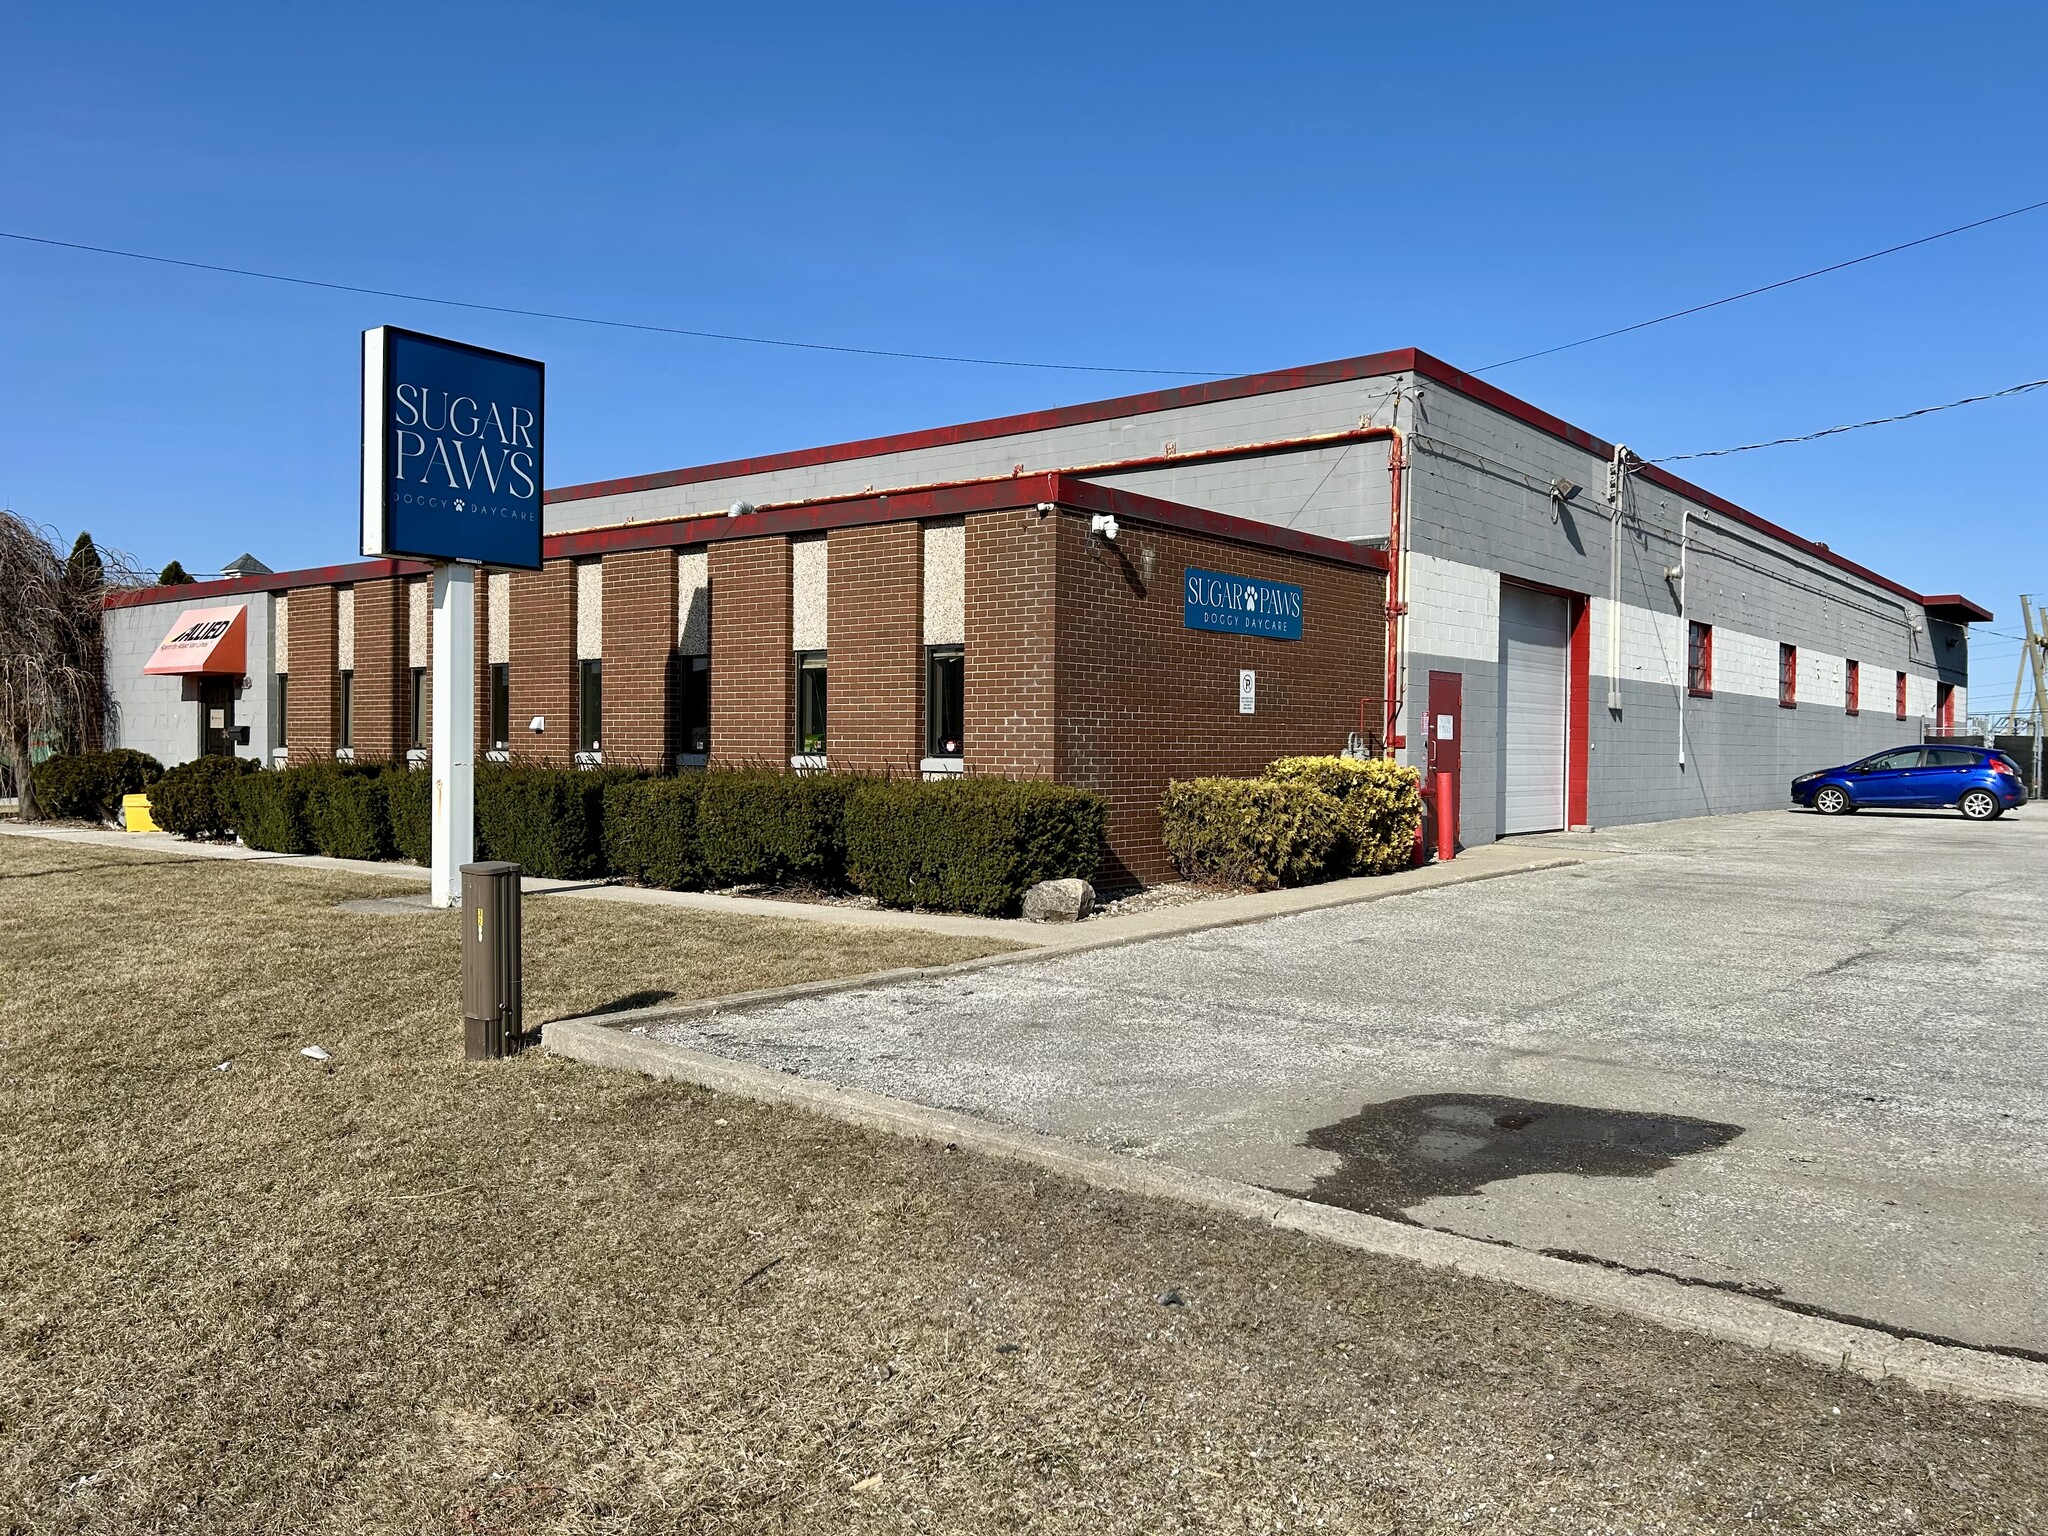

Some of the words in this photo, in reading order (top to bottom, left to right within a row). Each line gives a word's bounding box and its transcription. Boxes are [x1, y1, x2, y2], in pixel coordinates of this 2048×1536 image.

[395, 383, 534, 449] SUGAR
[394, 429, 535, 499] PAWS
[393, 492, 447, 508] DOGGY
[471, 503, 534, 521] DAYCARE
[1188, 576, 1242, 610] SUGAR
[1259, 587, 1300, 618] PAWS
[171, 620, 230, 642] ALLIED
[1204, 612, 1239, 626] DOGGY
[1245, 617, 1287, 632] DAYCARE
